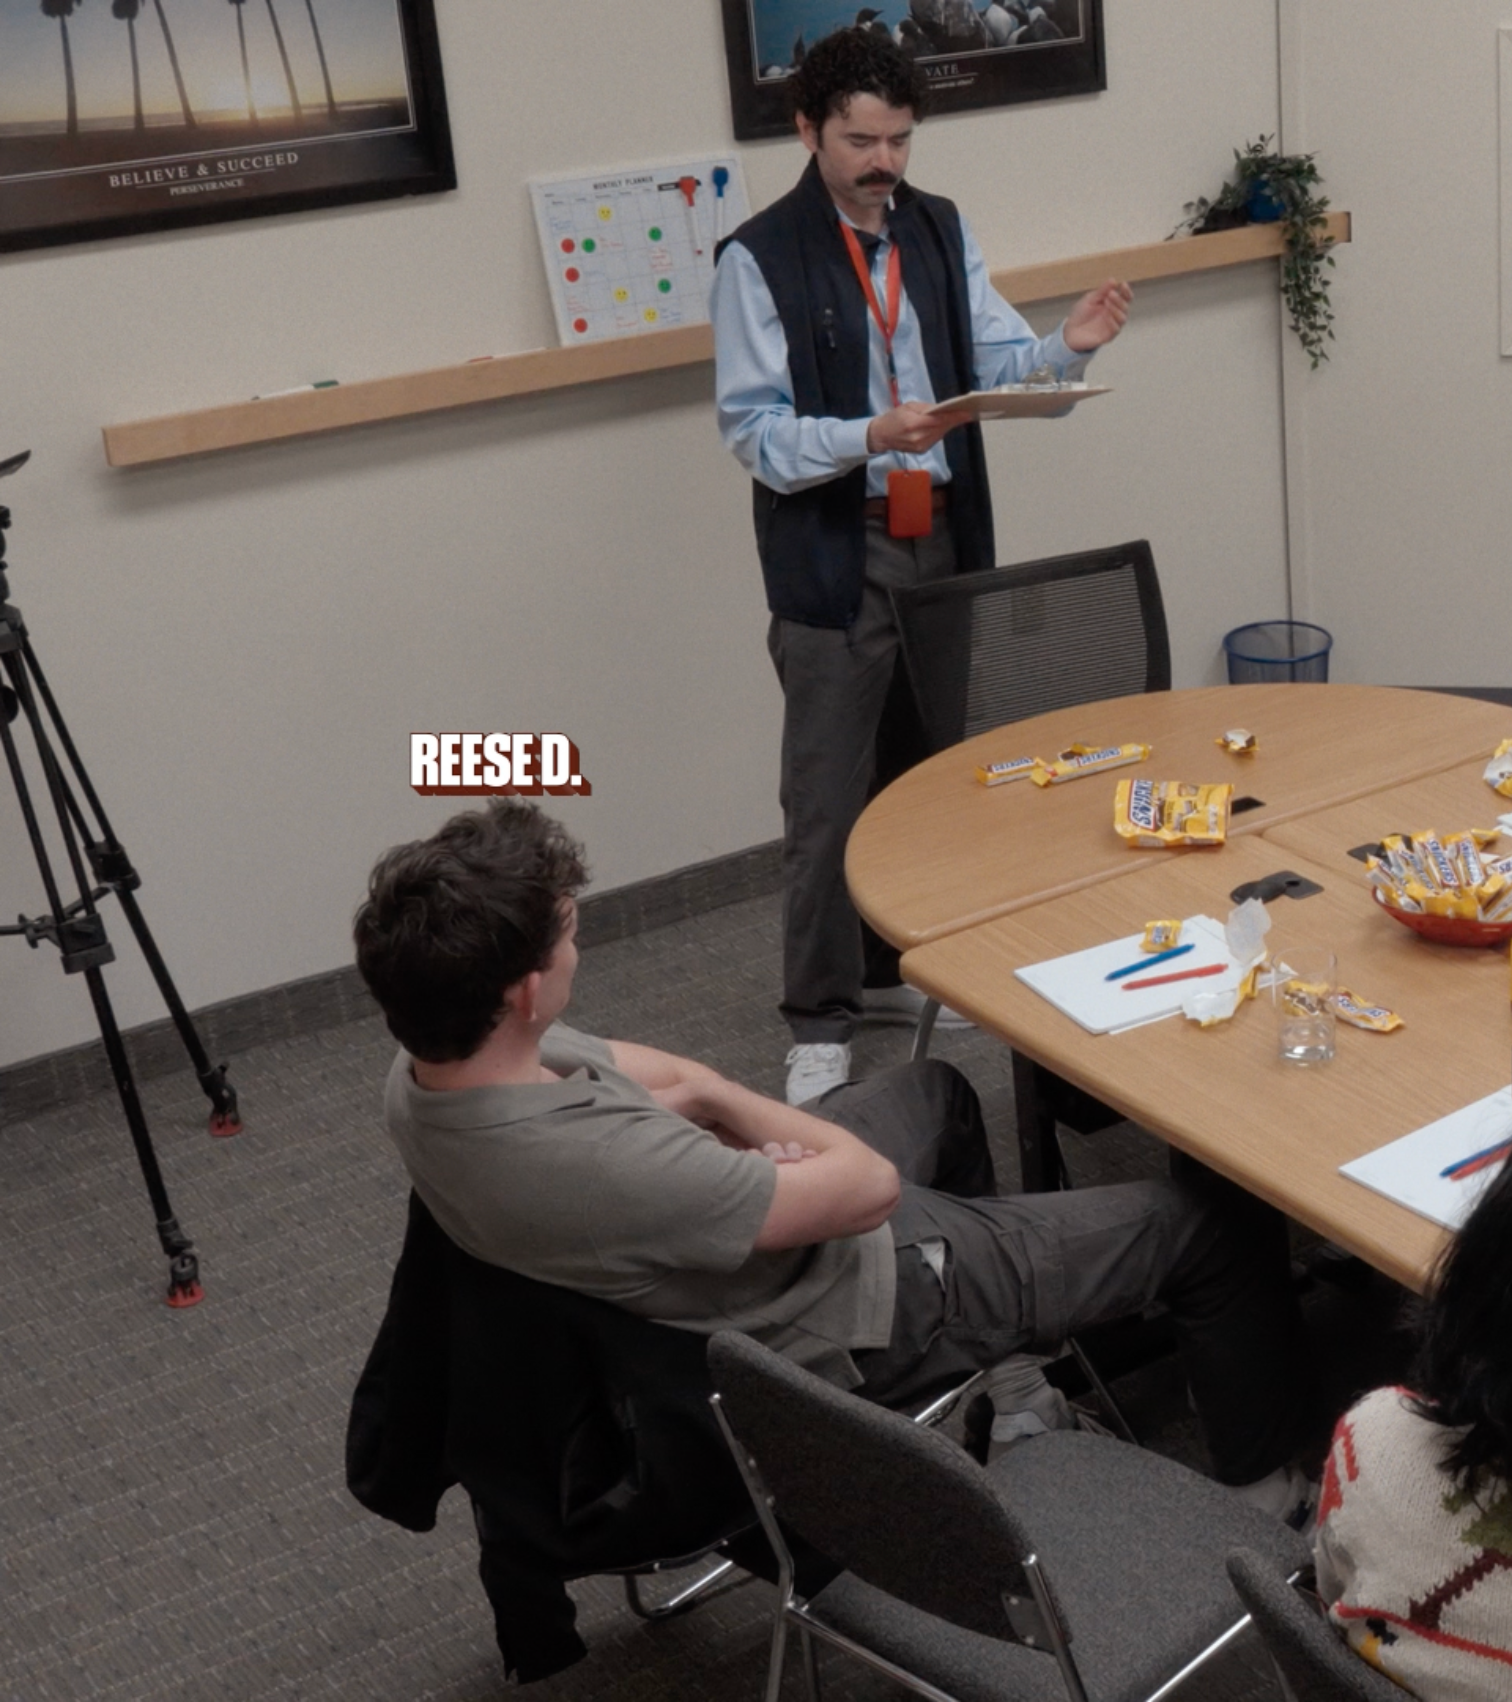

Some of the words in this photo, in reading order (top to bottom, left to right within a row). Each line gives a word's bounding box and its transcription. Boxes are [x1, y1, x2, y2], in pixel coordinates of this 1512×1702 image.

[109, 165, 190, 188] BELIEVE
[197, 163, 209, 176] &
[217, 152, 299, 174] SUCCEED
[169, 178, 245, 196] PERSEVERANCE
